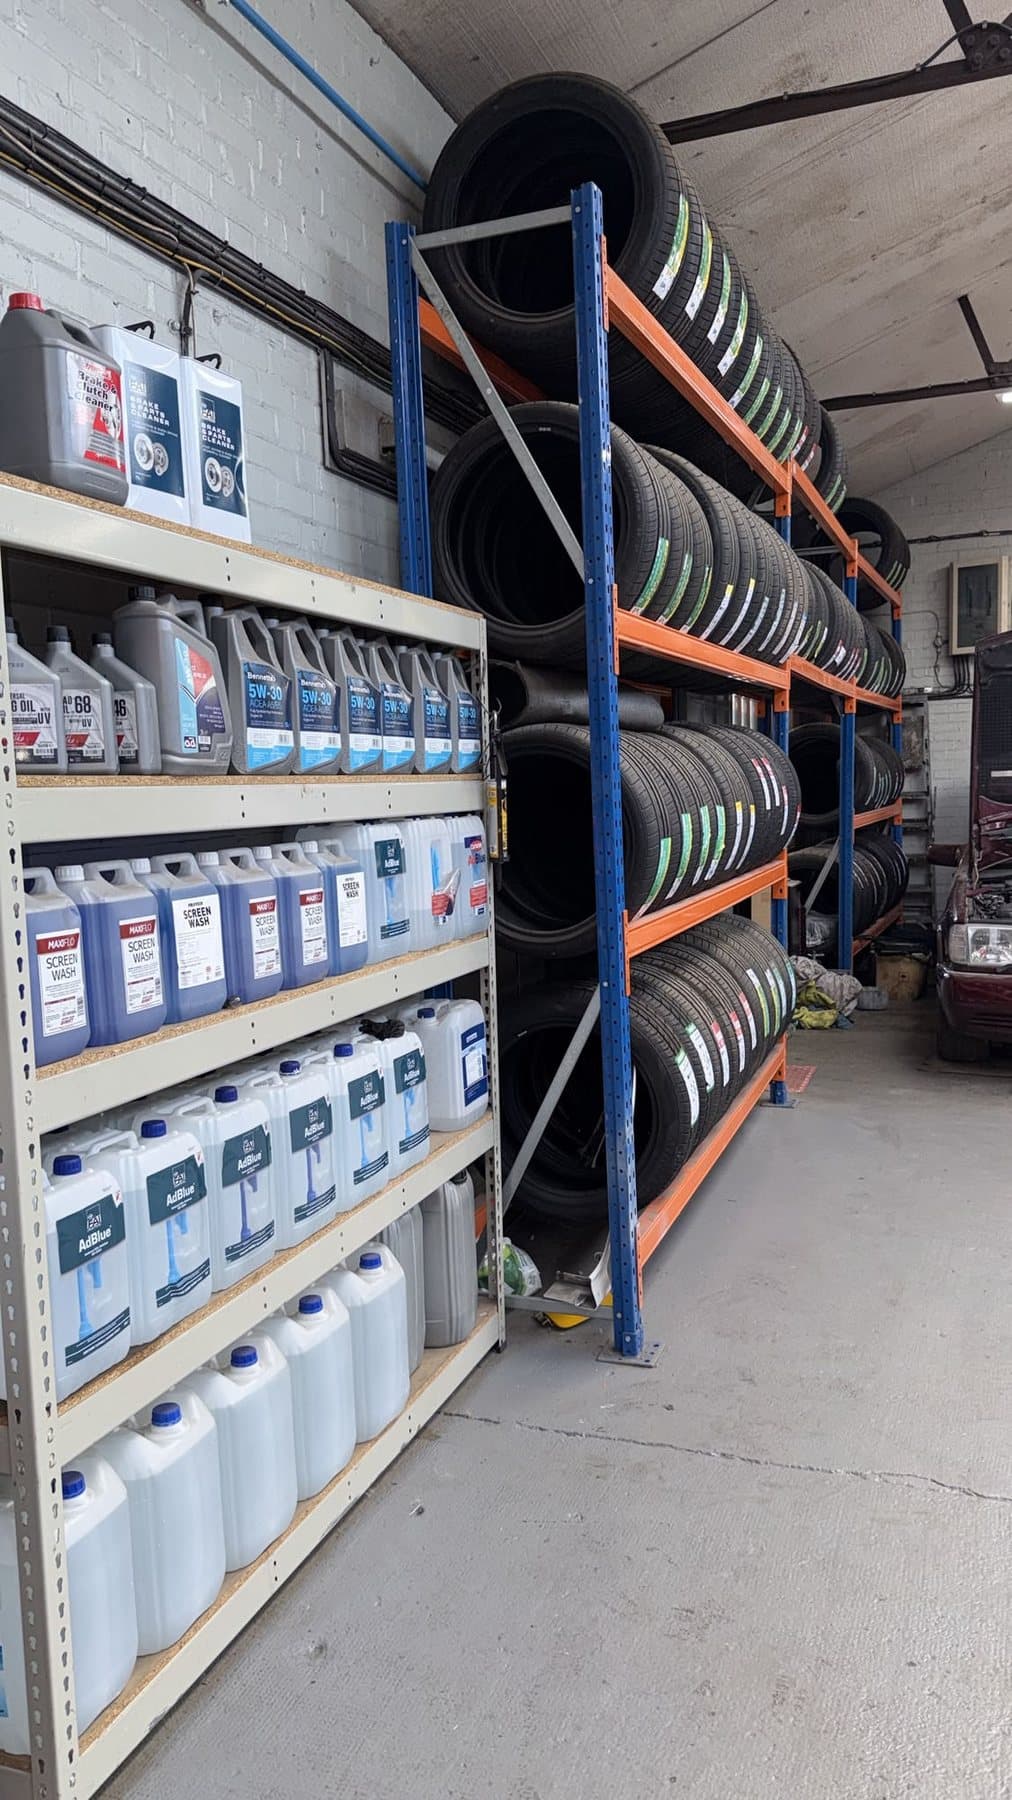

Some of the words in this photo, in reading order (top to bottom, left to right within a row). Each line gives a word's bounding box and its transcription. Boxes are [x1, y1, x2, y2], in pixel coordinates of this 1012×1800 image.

[248, 683, 282, 701] 5W-30
[302, 690, 332, 706] 5W-30
[20, 700, 36, 713] OIL
[74, 695, 92, 714] 68
[351, 696, 376, 710] 5W-30
[384, 700, 408, 714] 5W-30
[38, 712, 51, 724] UV
[426, 704, 446, 718] 5W-30
[460, 707, 476, 719] 5W-30
[82, 718, 92, 728] UV
[183, 906, 212, 920] SCREEN
[188, 916, 210, 929] WASH
[259, 925, 274, 937] WASH
[128, 938, 156, 953] SCREEN
[46, 953, 78, 970] SCREEN
[133, 950, 154, 964] WASH
[52, 966, 76, 981] WASH
[304, 1121, 325, 1139] AdBlue
[238, 1152, 262, 1171] AdBlue
[166, 1185, 196, 1207] AdBlue
[78, 1228, 112, 1254] AdBlue
